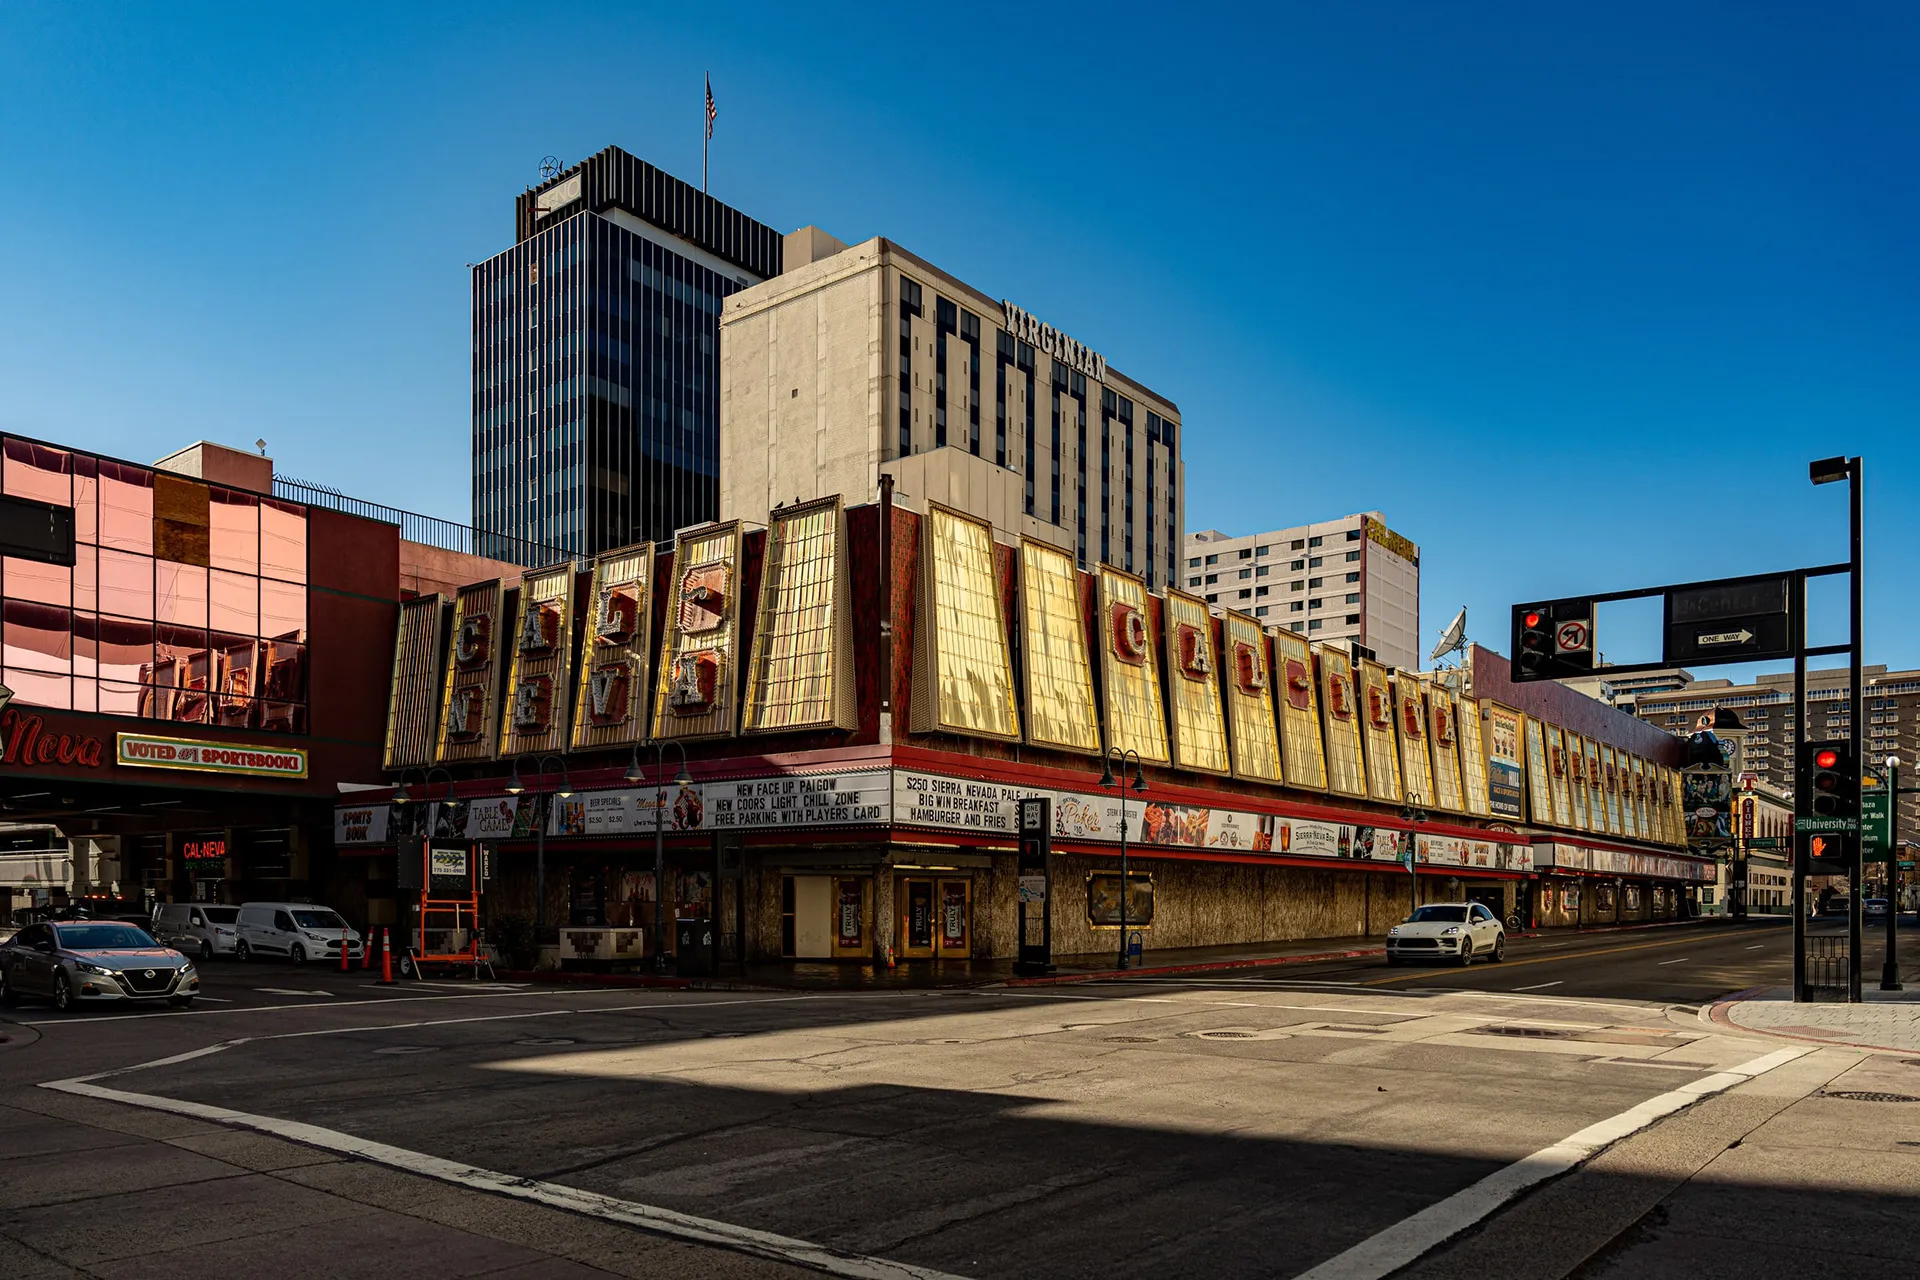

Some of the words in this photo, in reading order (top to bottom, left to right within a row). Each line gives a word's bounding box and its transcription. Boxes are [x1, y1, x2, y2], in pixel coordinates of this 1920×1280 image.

[1002, 299, 1107, 384] VIRGINIAN
[1702, 635, 1719, 643] ONE
[1723, 633, 1740, 641] WAY
[2, 708, 104, 768] Neva
[126, 742, 176, 760] VOTED
[736, 783, 754, 796] NEW
[757, 782, 780, 795] FACE
[782, 781, 795, 794] UP
[931, 779, 962, 795] SIERRA
[966, 784, 998, 800] NEVADA
[1001, 788, 1021, 802] PALE
[590, 798, 600, 808] BEER
[600, 797, 621, 806] SPECIALS
[716, 799, 733, 812] NEW
[737, 797, 765, 810] COORS
[771, 796, 798, 809] LIGHT
[803, 793, 829, 807] CHILL
[835, 791, 860, 804] ZONE
[919, 793, 934, 807] BIG
[936, 795, 951, 809] WIN
[953, 798, 999, 813] BREAKFAST
[342, 810, 372, 826] SPORTS
[472, 806, 499, 821] TABLE
[608, 815, 623, 823] $2.50
[715, 813, 735, 826] FREE
[739, 811, 777, 825] PARKING
[781, 810, 803, 823] WITH
[805, 807, 849, 822] PLAYERS
[853, 806, 881, 819] CARD
[910, 807, 961, 824] HAMBURGER
[964, 814, 981, 826] AND
[983, 815, 1006, 829] FRIES
[1064, 803, 1100, 830] Poker
[1106, 808, 1118, 817] STEAK
[1123, 810, 1137, 819] OBSTER
[1870, 811, 1885, 819] Walk
[479, 819, 510, 833] GAMES
[1806, 818, 1847, 830] University
[345, 825, 368, 841] BOOK
[915, 906, 923, 932] TRULY
